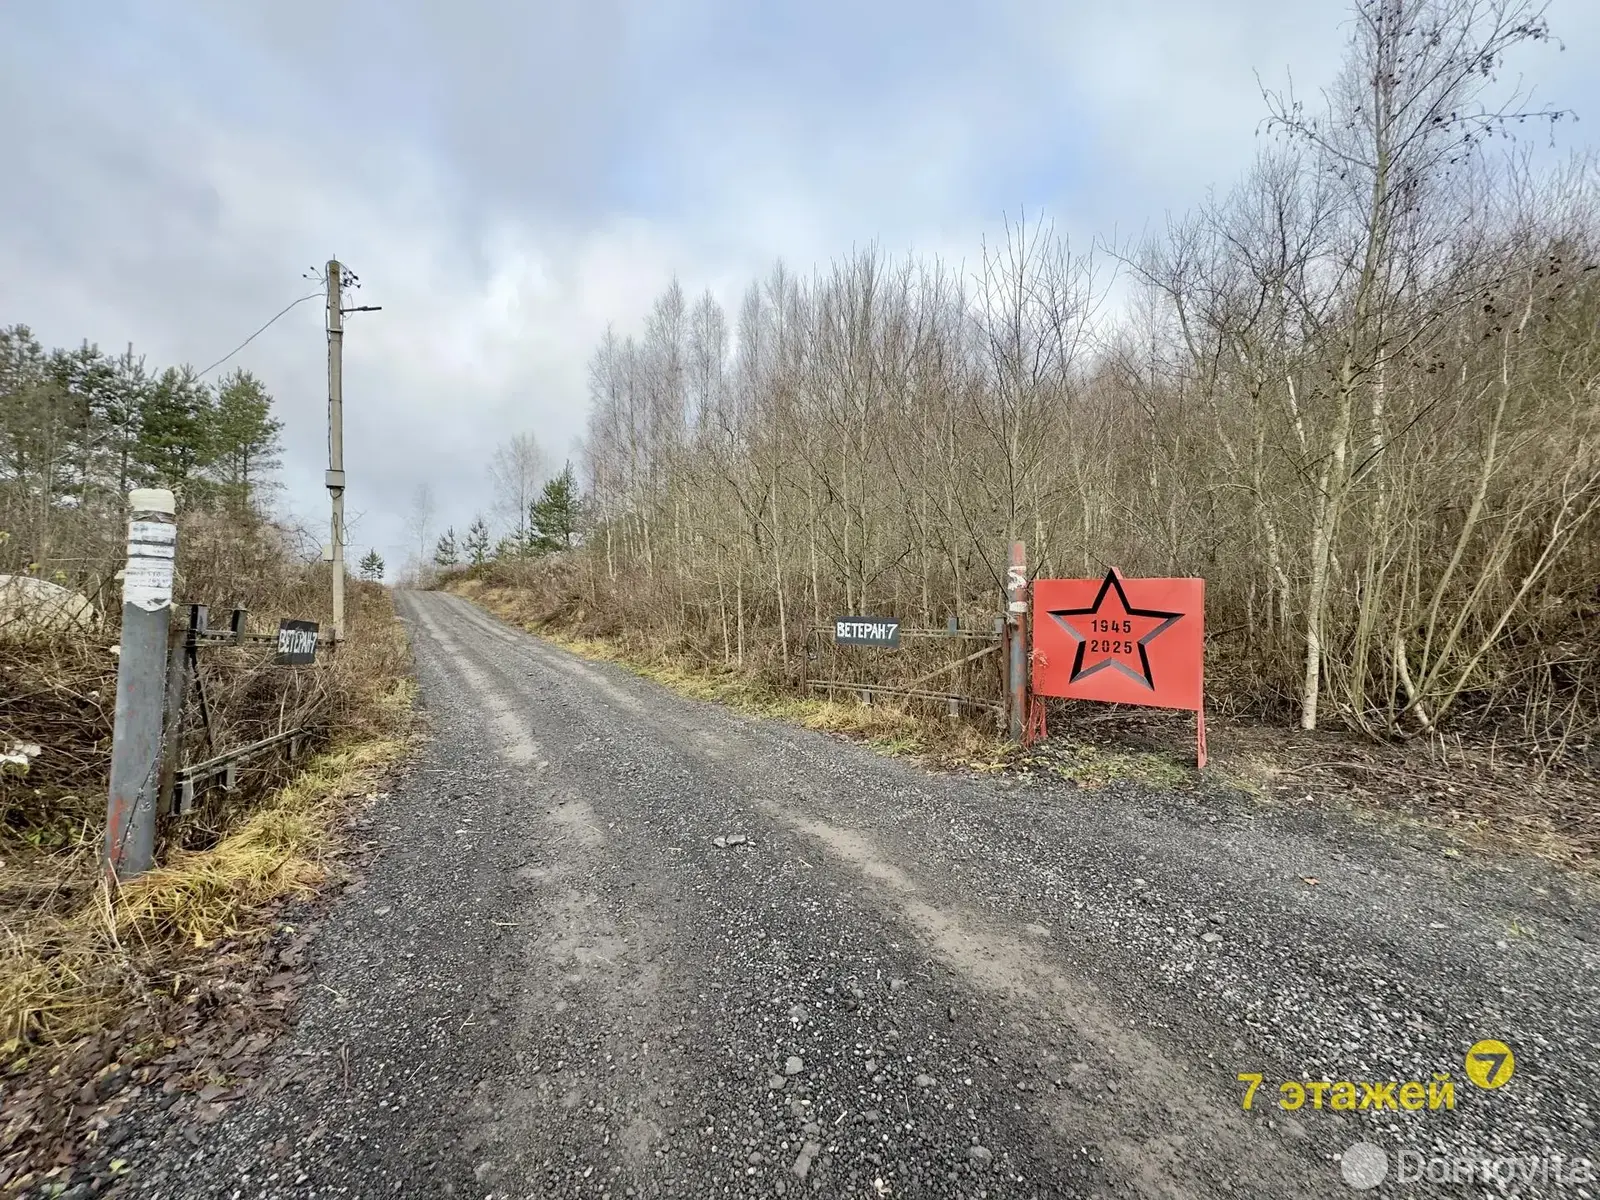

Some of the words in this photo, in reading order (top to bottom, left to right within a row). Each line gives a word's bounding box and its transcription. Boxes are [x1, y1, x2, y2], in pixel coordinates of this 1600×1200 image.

[836, 622, 898, 639] ВЕТЕРАН-7
[1091, 620, 1131, 633] 1945
[1090, 640, 1132, 654] 2025
